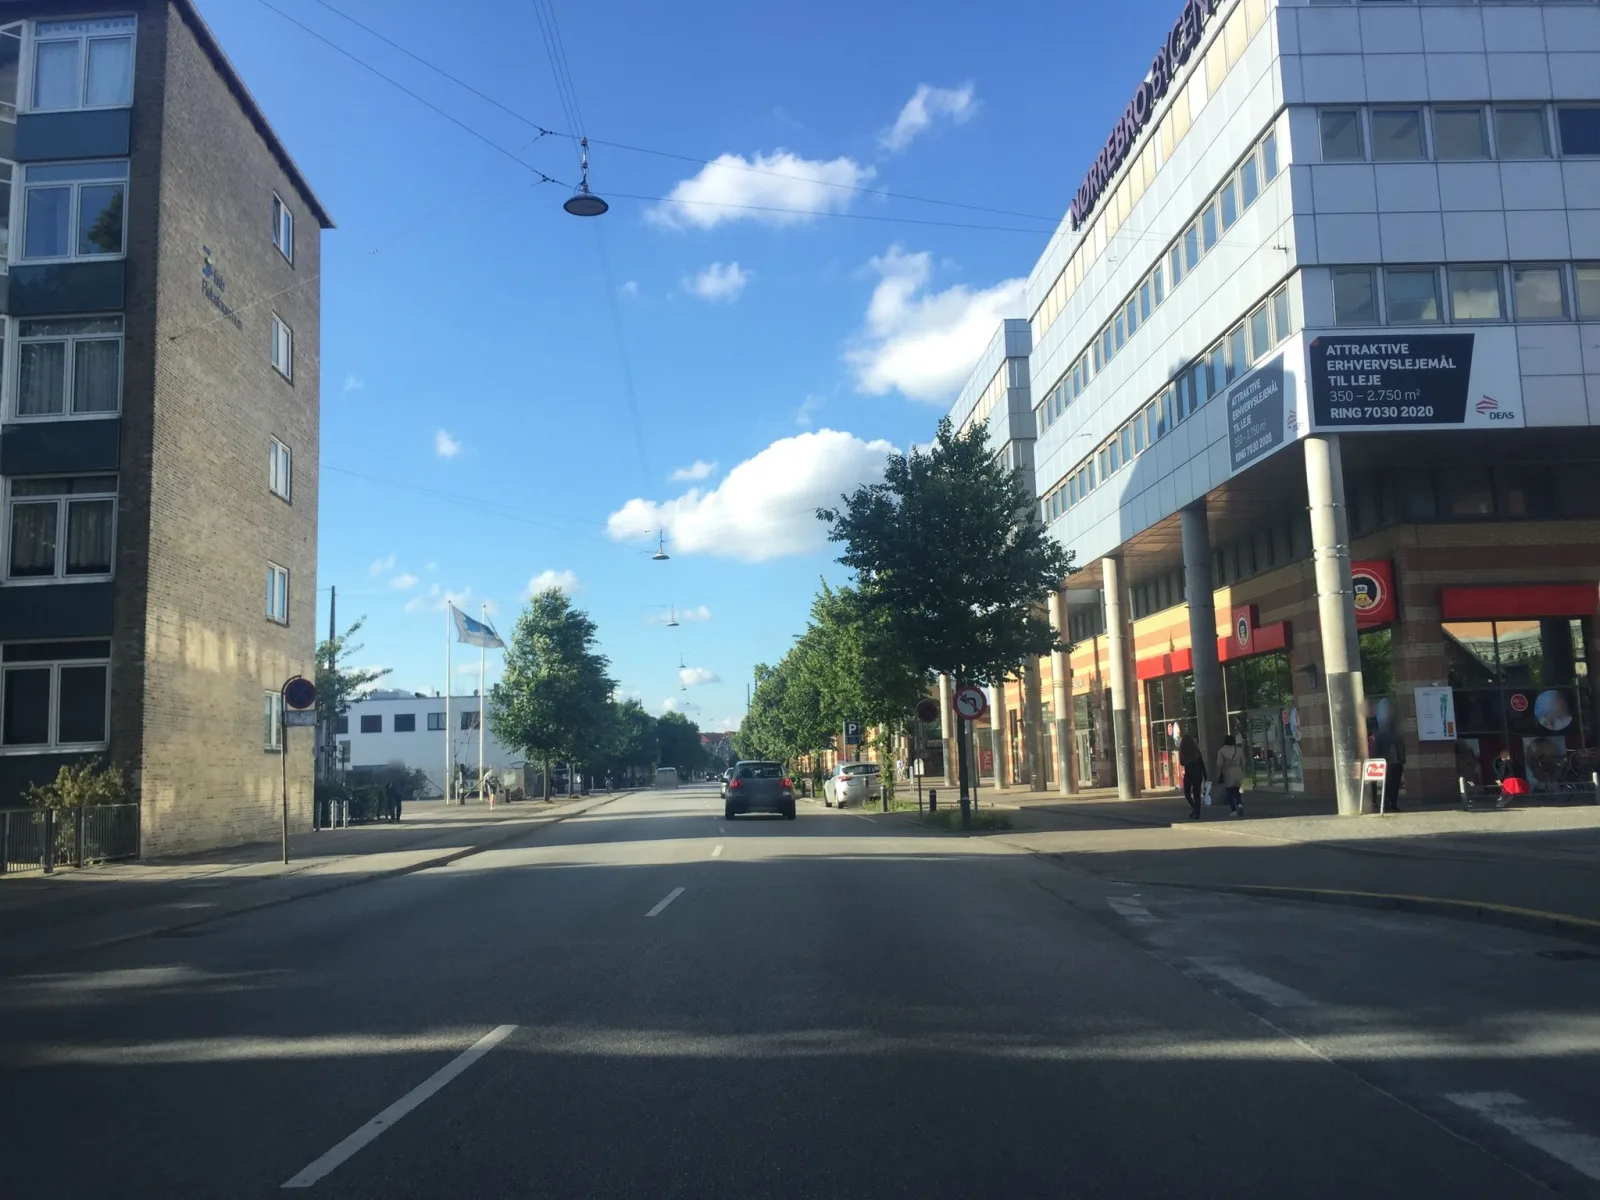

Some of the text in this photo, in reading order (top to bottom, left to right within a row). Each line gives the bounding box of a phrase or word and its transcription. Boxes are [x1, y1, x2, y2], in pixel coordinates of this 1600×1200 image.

[1070, 0, 1224, 231] NØRREBRO BYCEN
[1326, 343, 1409, 356] ATTRAKTIVE
[1327, 355, 1456, 371] ERHVERVSLEJEMÅL
[1328, 374, 1381, 386] TIL LEJE
[1231, 378, 1261, 407] ATTRAKTIVE
[1329, 390, 1353, 402] 350
[1367, 389, 1402, 401] 2.750
[1330, 406, 1434, 418] RING 7030 2020
[1489, 411, 1515, 420] DEAS
[1233, 414, 1252, 434] TIL LEJE
[1246, 440, 1259, 457] 7030
[1259, 432, 1273, 449] 2020
[848, 723, 857, 735] P
